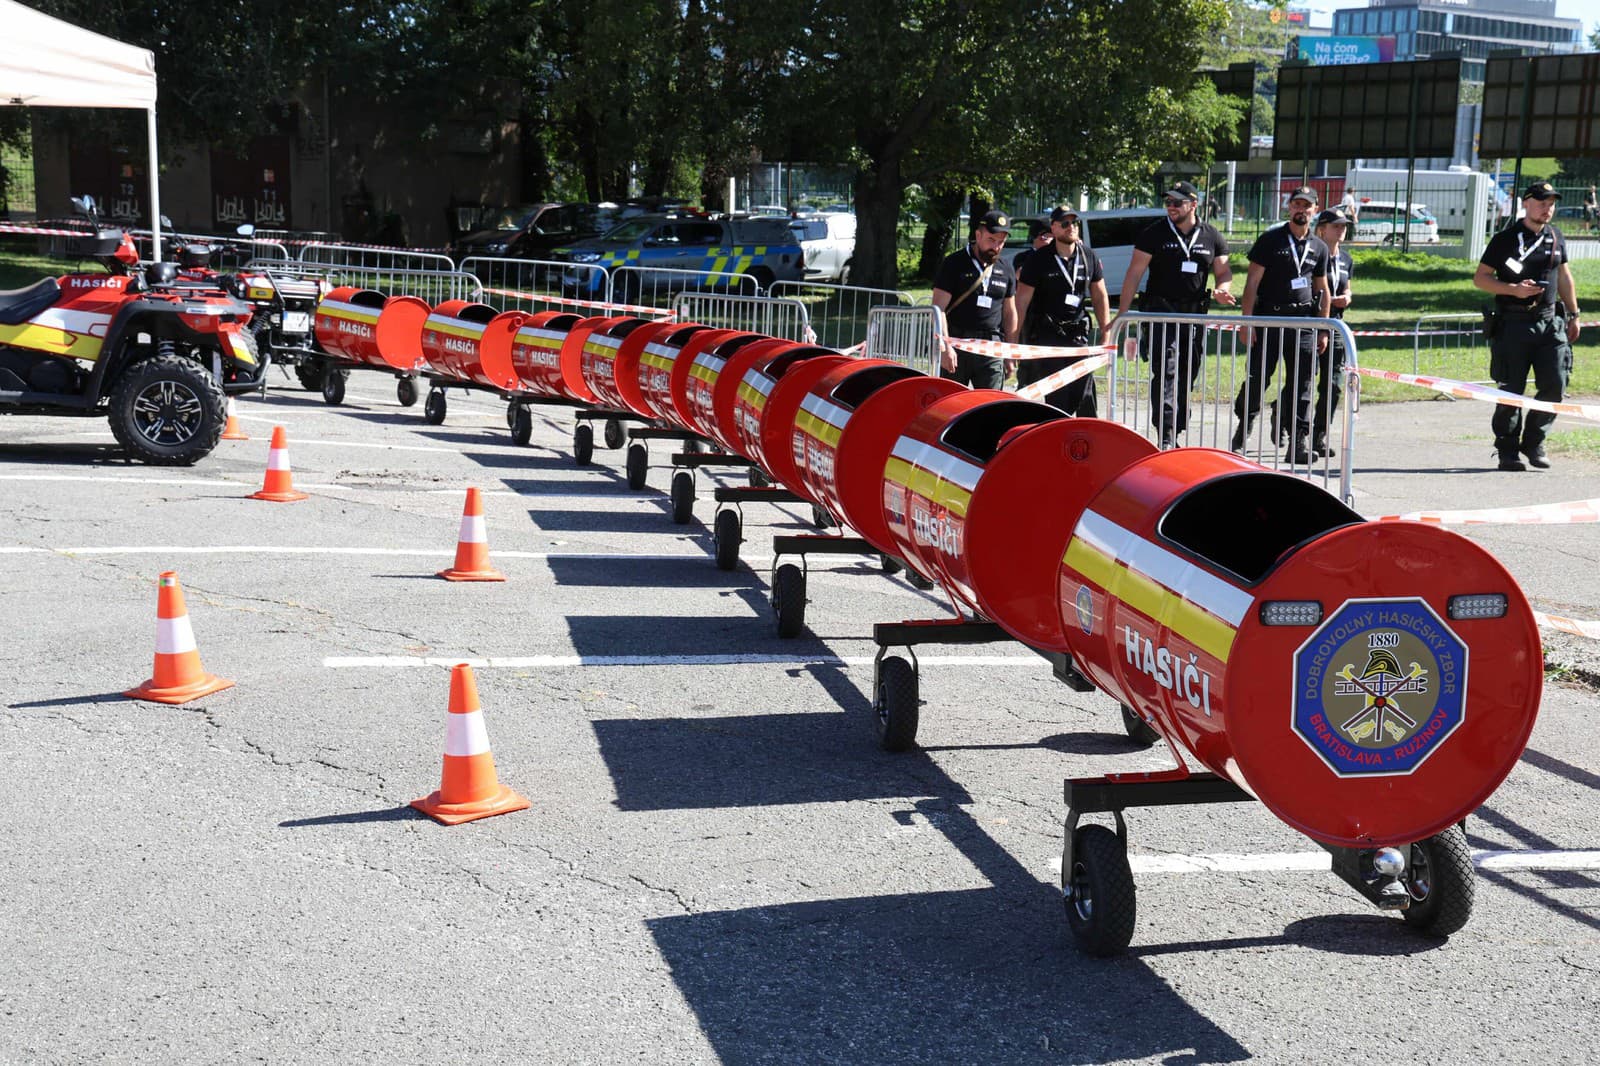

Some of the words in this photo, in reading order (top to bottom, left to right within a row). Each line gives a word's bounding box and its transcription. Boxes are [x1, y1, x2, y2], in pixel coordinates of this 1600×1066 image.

[1315, 42, 1331, 53] Na
[1333, 42, 1358, 53] čom
[71, 278, 122, 288] HASIČI
[339, 320, 371, 338] HASIČI
[445, 338, 475, 355] HASIČI
[914, 507, 962, 560] HASIČI
[1367, 631, 1400, 648] 1880
[1305, 611, 1374, 700] DOBROVOĽNÝ
[1379, 610, 1448, 651] HASIČSKÝ
[1438, 652, 1456, 695] ZBOR
[1124, 624, 1212, 718] HASIČI
[1309, 713, 1383, 765] BRATISLAVA
[1395, 708, 1449, 761] RUŽINOV
